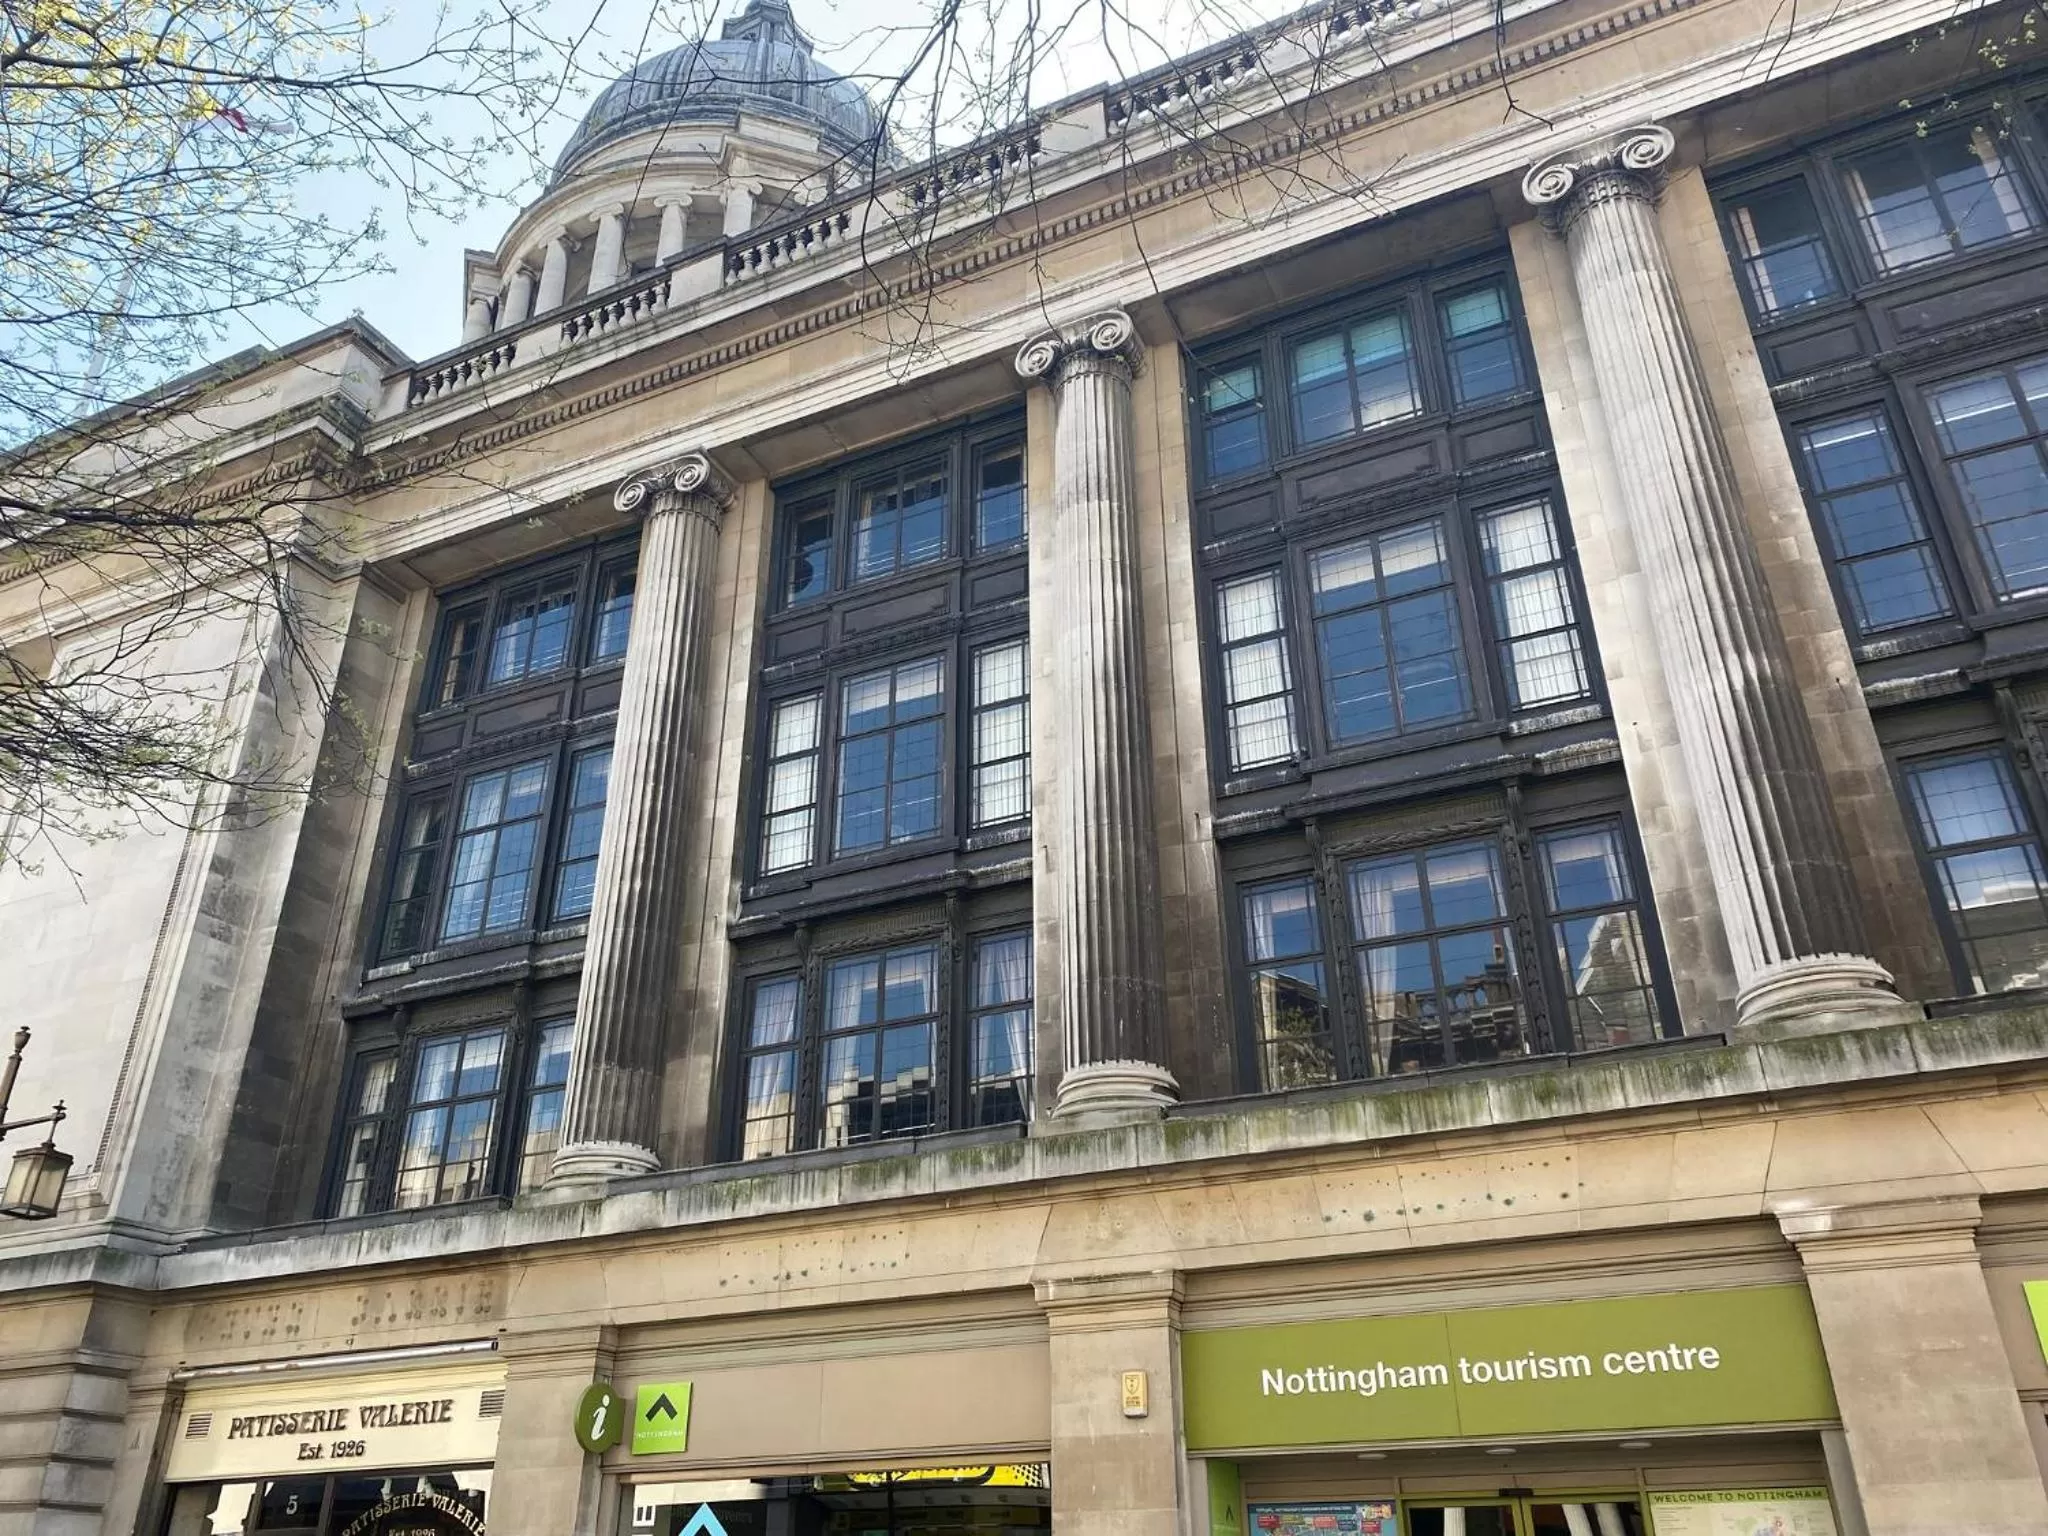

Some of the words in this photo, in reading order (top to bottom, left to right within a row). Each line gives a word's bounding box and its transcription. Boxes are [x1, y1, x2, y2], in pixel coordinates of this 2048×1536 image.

[1261, 1361, 1449, 1397] Nottingham
[1458, 1351, 1592, 1384] tourism
[1603, 1343, 1720, 1375] centre
[228, 1408, 350, 1440] PATISSERIE
[359, 1399, 455, 1429] VALERIE
[297, 1442, 325, 1460] Est.
[331, 1440, 366, 1458] 1926
[286, 1495, 298, 1515] 5
[1654, 1492, 1713, 1503] WELCOME
[1717, 1492, 1734, 1501] TO
[1738, 1490, 1822, 1501] NOTTINGHAM
